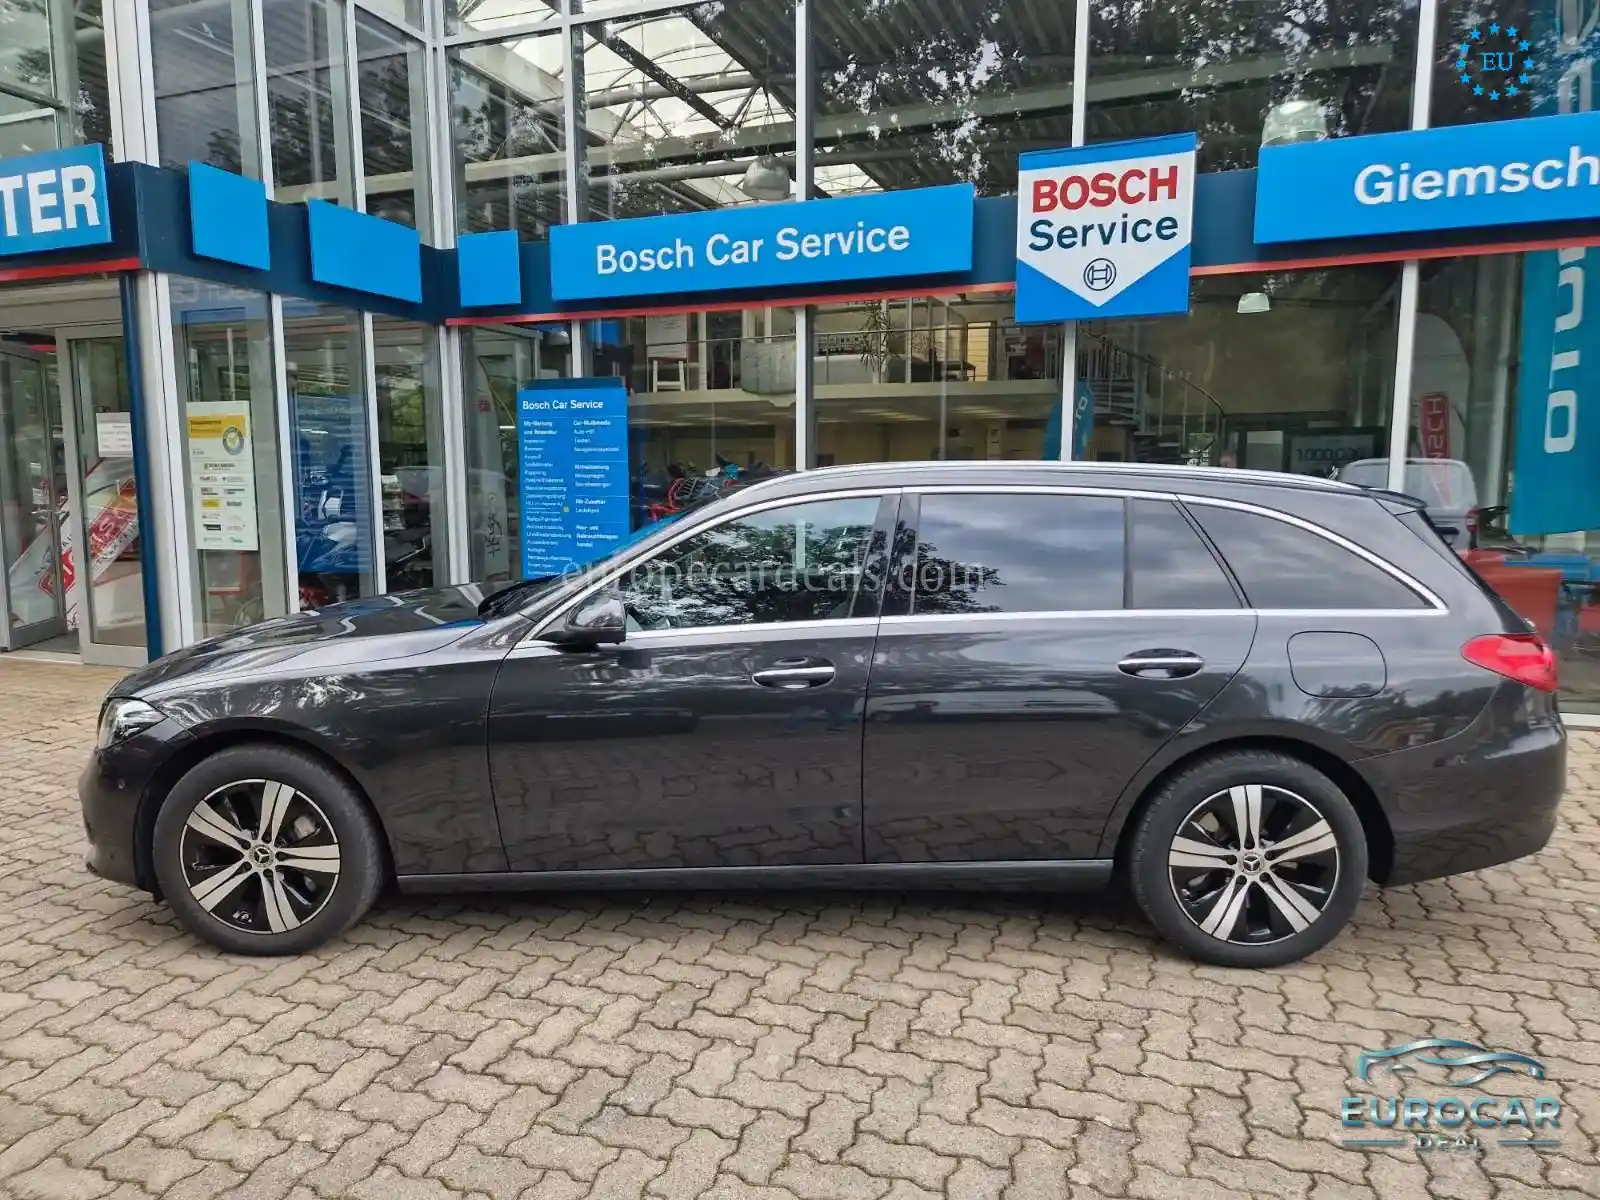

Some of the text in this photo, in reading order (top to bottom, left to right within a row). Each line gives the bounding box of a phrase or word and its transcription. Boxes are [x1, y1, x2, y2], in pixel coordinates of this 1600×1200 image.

[1032, 166, 1178, 213] BOSCH
[1354, 145, 1600, 205] Giemsch
[596, 221, 910, 276] Bosch Car Service
[1029, 213, 1178, 251] Service
[523, 399, 604, 410] Bosch Car Service
